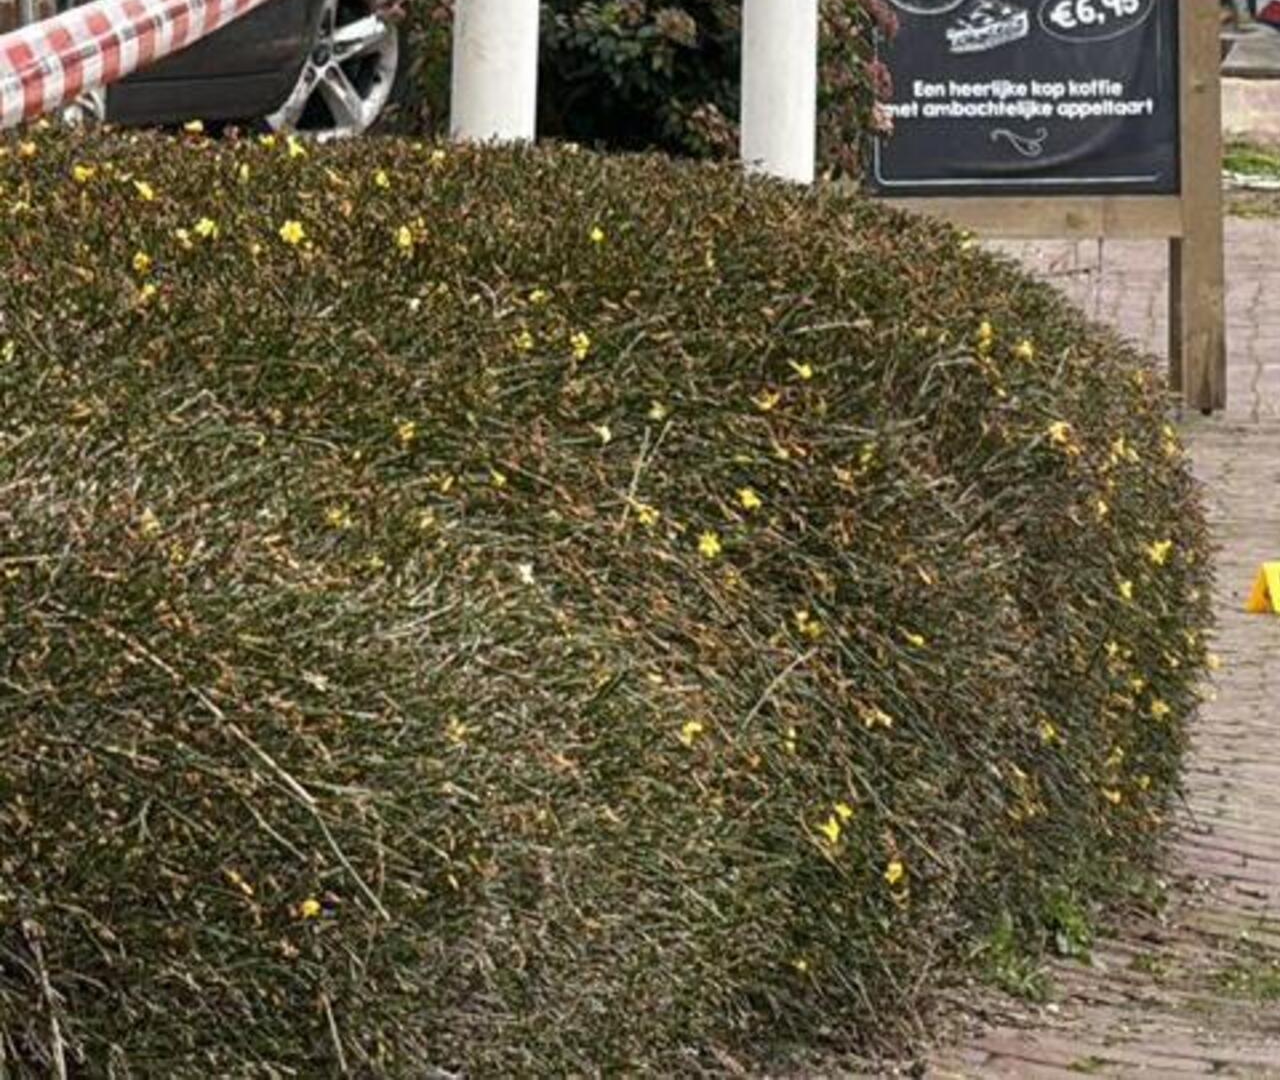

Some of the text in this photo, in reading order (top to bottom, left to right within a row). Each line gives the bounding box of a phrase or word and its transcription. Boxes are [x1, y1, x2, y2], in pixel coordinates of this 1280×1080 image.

[913, 79, 1124, 100] Een heerlijke kop koffie
[921, 100, 1053, 120] ambachtelijke
[1056, 98, 1154, 119] appeltaart
